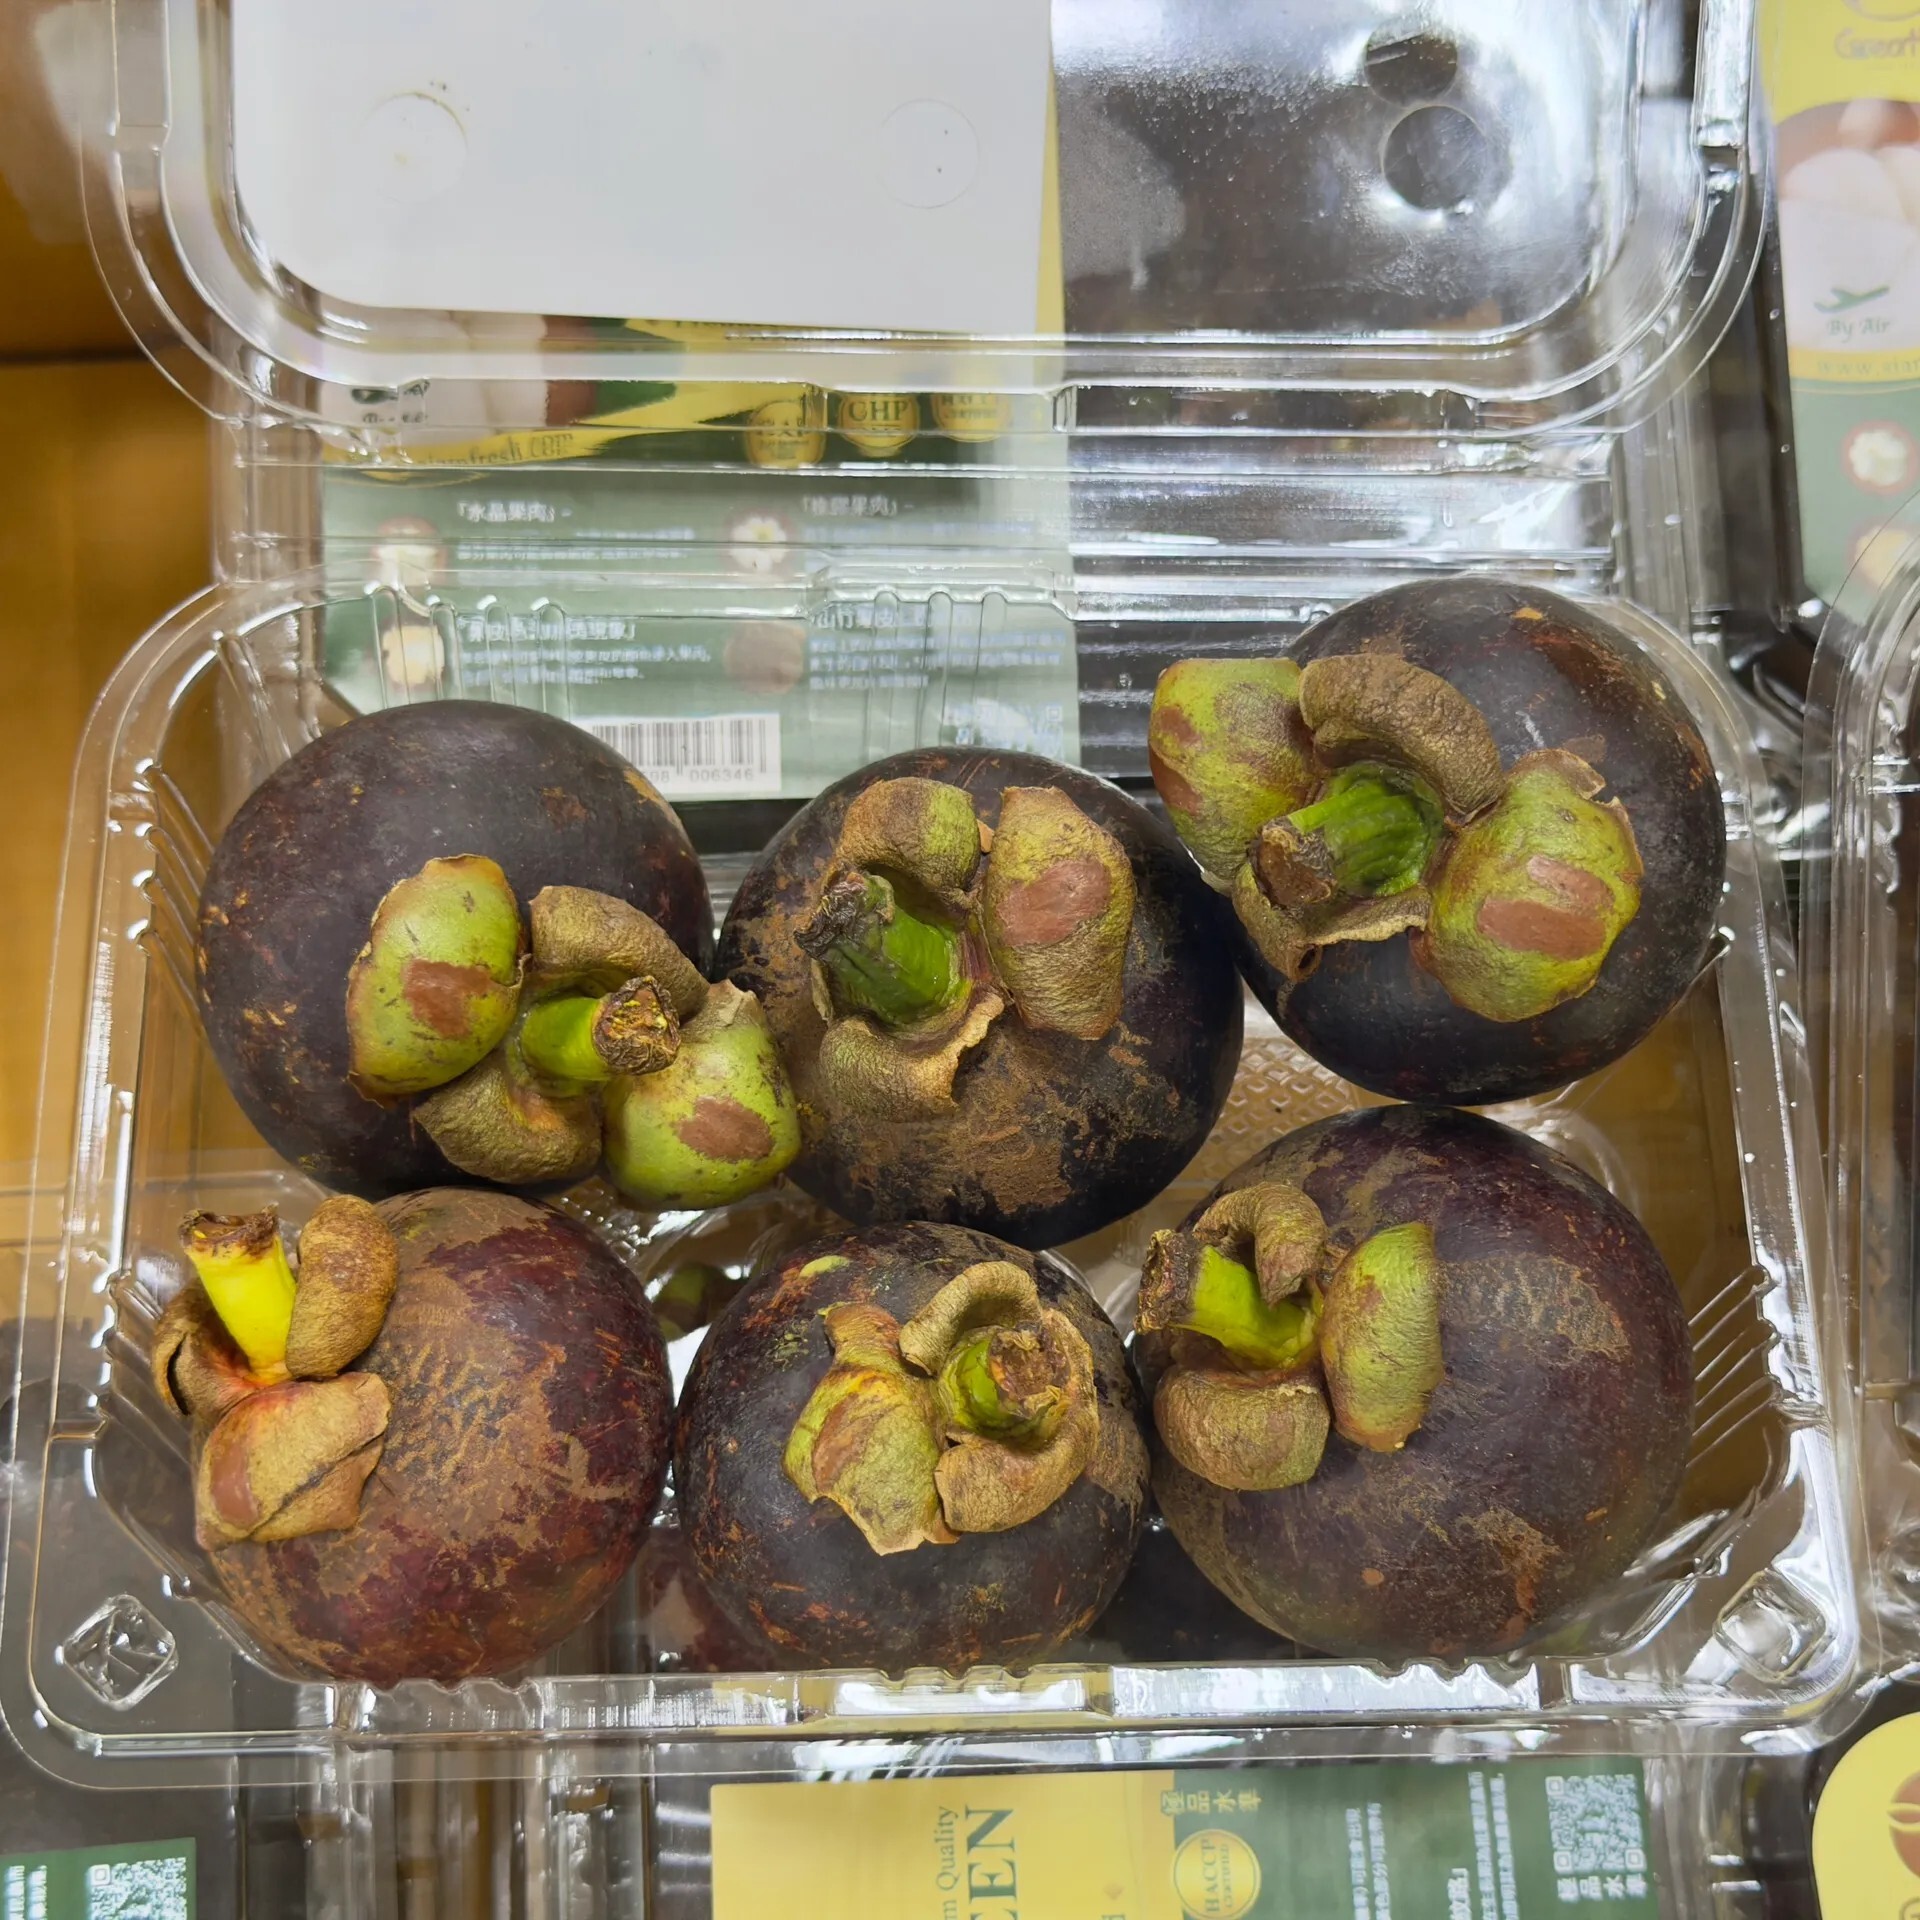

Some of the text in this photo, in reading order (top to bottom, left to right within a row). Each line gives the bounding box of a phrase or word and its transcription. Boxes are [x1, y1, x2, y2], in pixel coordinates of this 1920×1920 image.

[1826, 316, 1891, 344] By Air
[1160, 1788, 1262, 1816] 極品水準
[935, 1806, 961, 1891] Quality
[1201, 1837, 1221, 1913] HACCP
[1556, 1873, 1648, 1901] 極品水準
